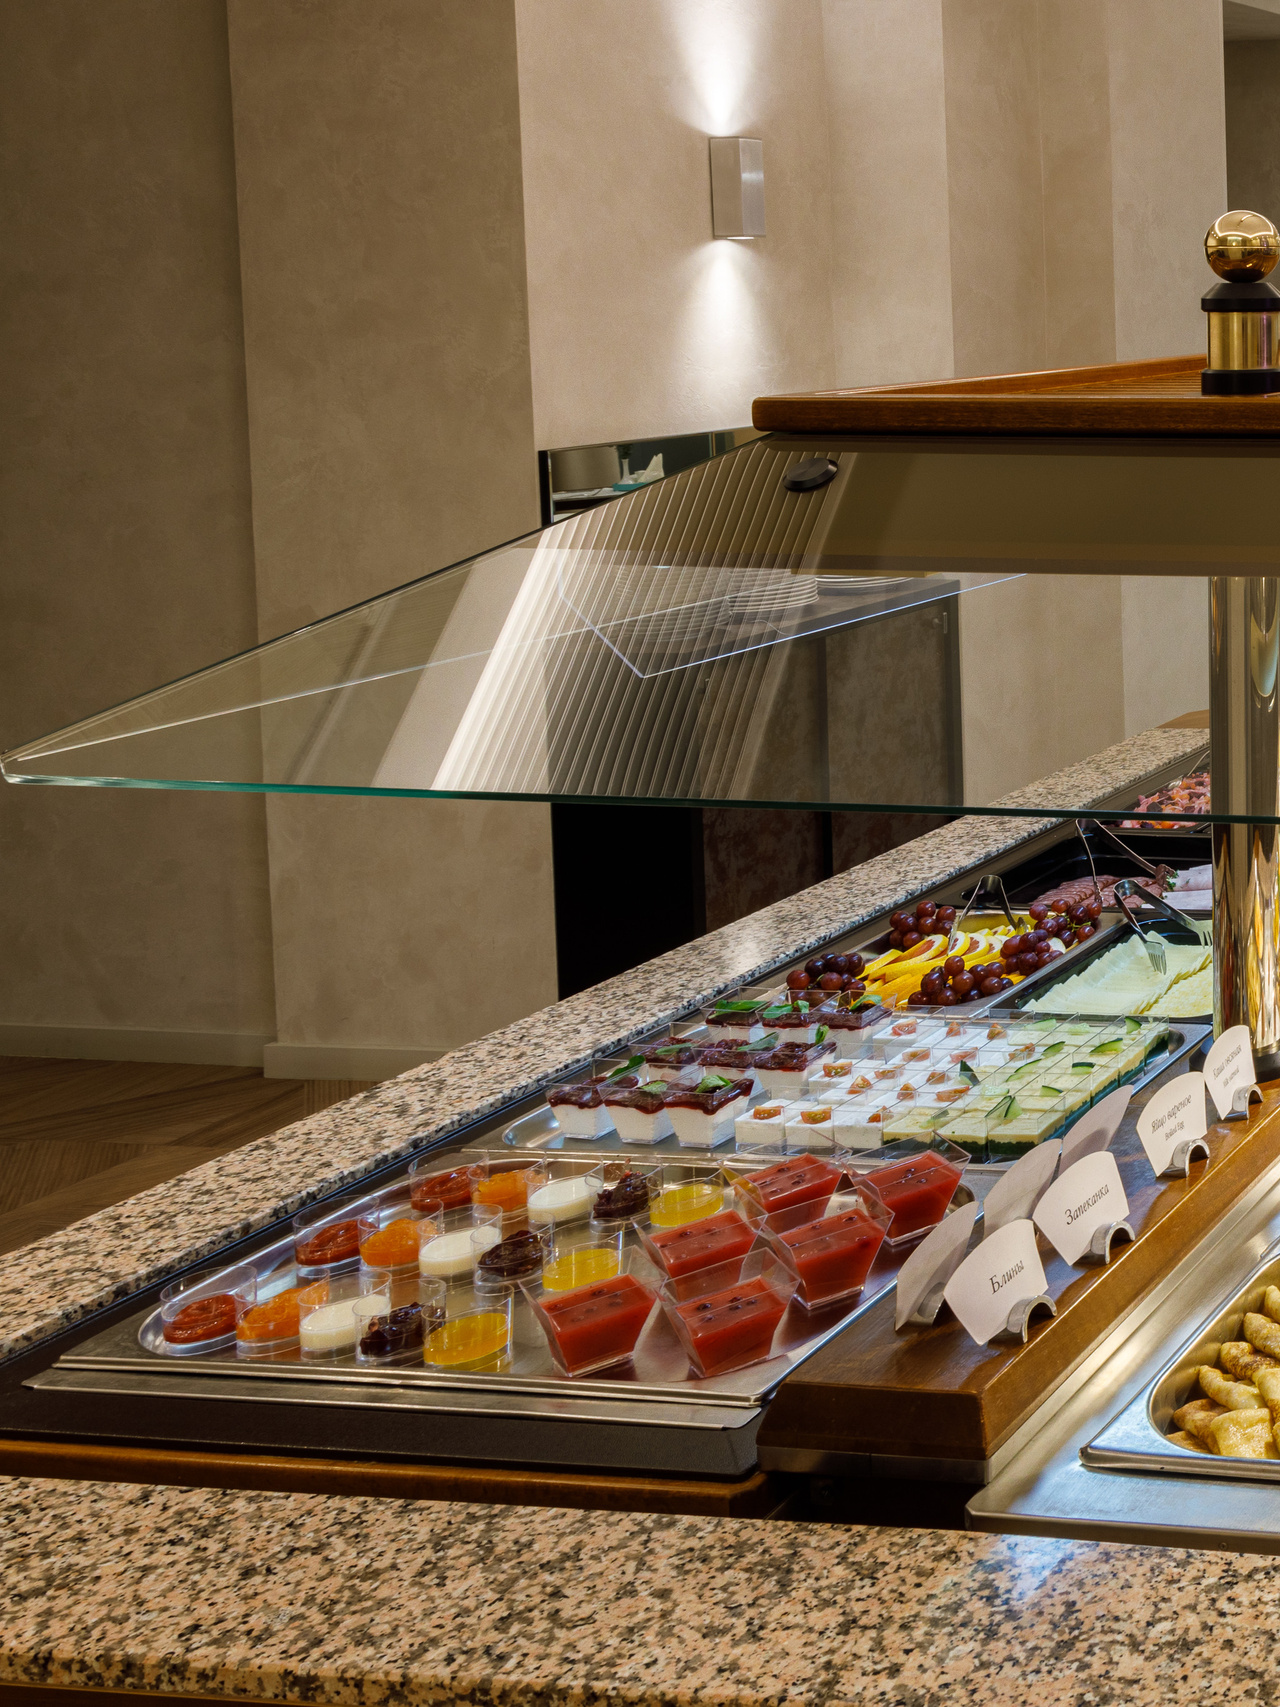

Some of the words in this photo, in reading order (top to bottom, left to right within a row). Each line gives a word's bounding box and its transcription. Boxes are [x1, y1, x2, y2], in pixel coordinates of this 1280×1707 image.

[1151, 1114, 1167, 1135] Яйцо
[1064, 1184, 1110, 1226] Запеканка
[989, 1259, 1025, 1295] Блины
